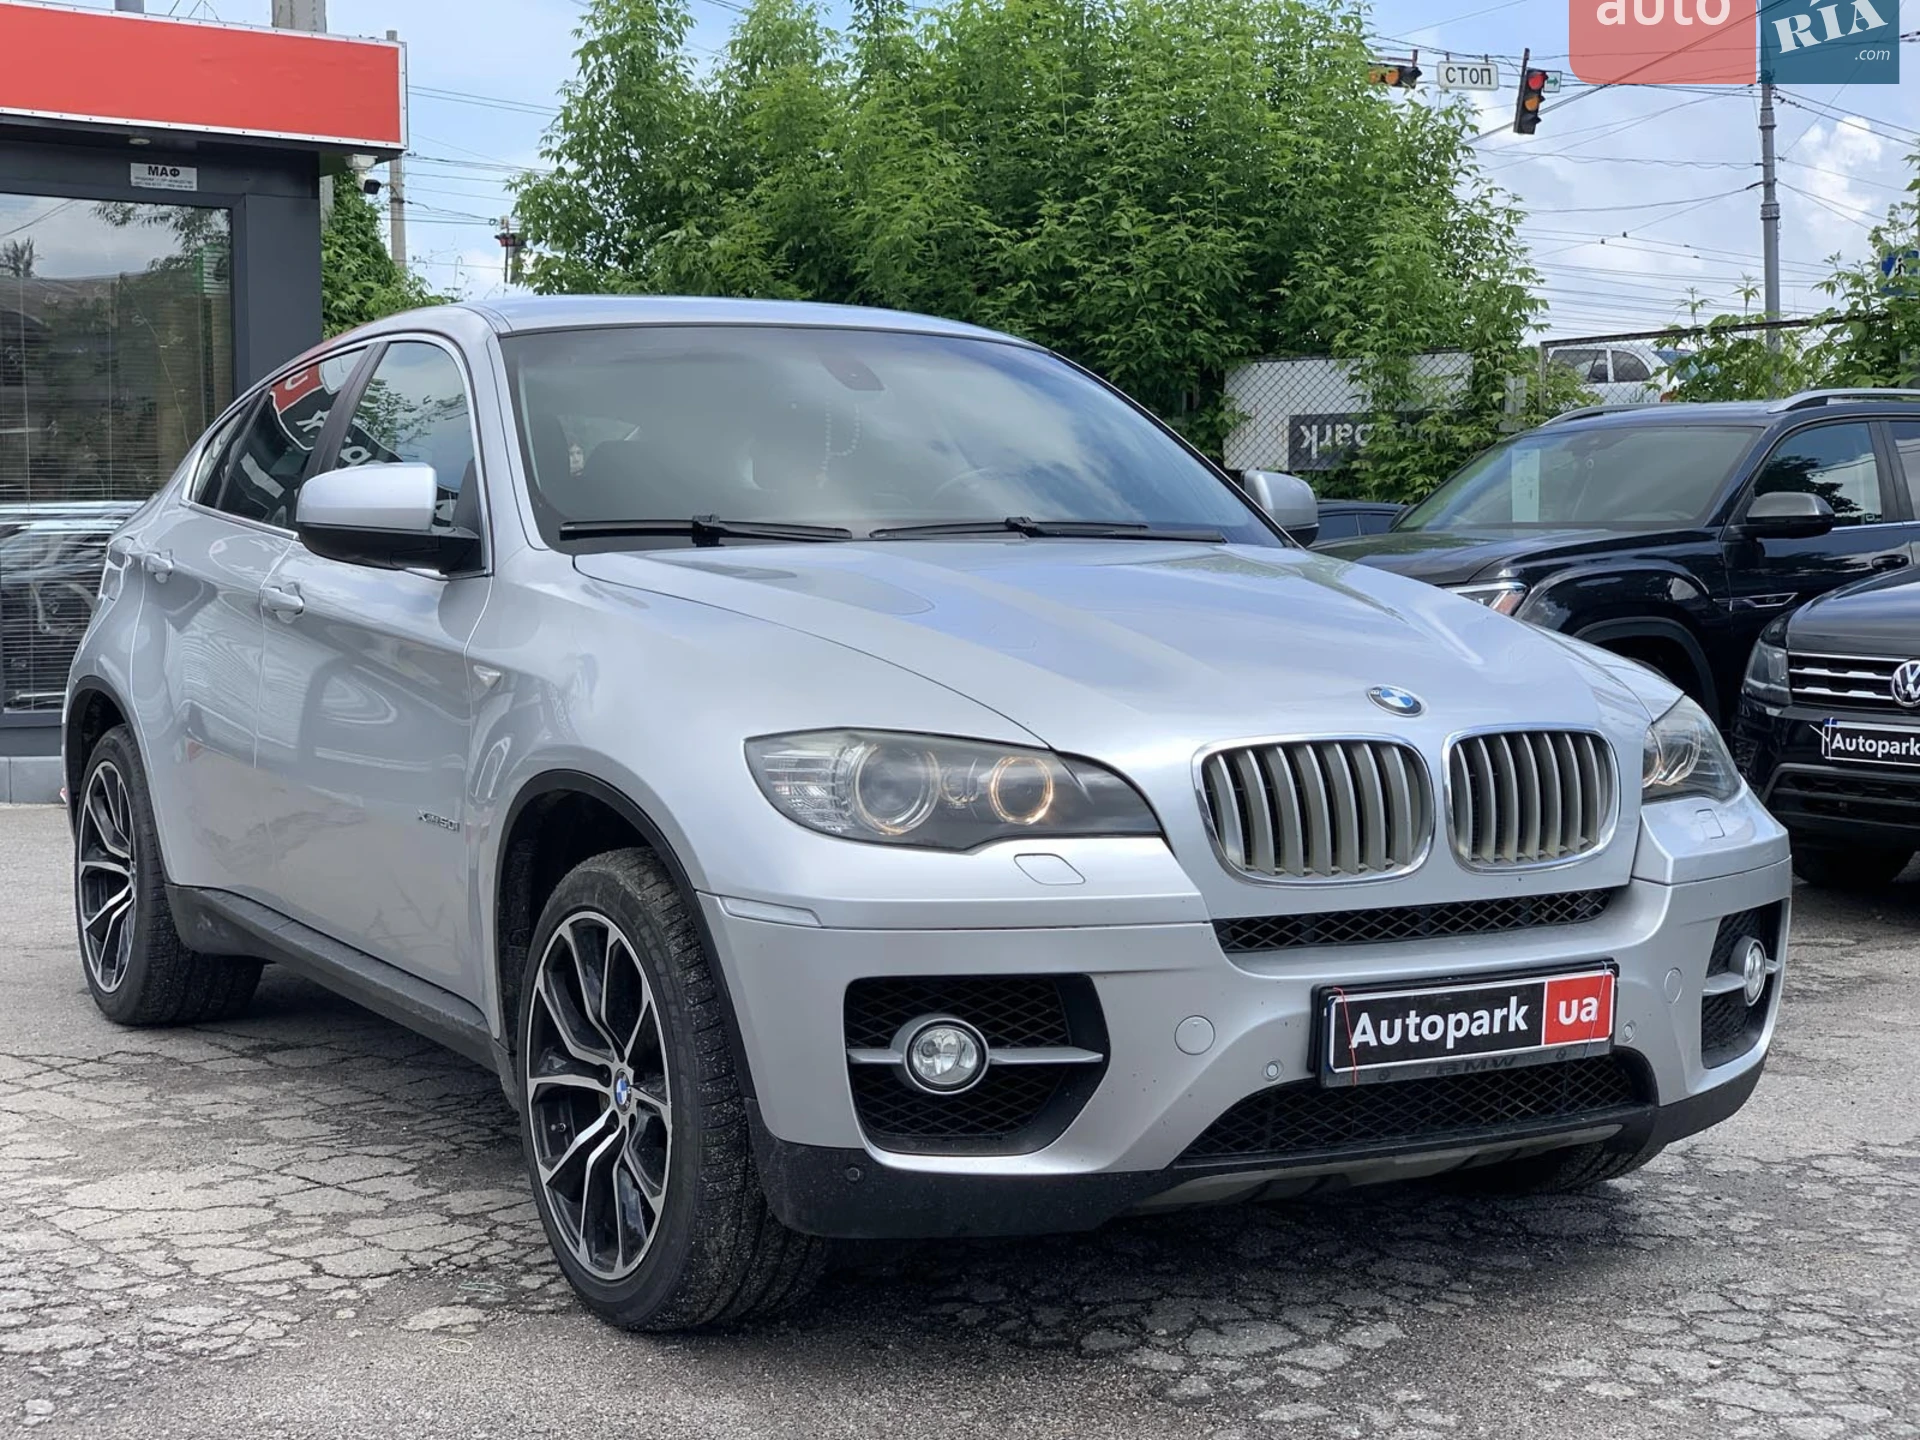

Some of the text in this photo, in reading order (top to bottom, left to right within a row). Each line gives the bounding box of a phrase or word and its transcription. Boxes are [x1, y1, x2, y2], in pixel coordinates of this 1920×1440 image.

[1445, 66, 1492, 85] СТОП
[147, 165, 181, 178] МАФ
[1831, 733, 1920, 758] Autopark
[1349, 996, 1599, 1049] Autopark ua
